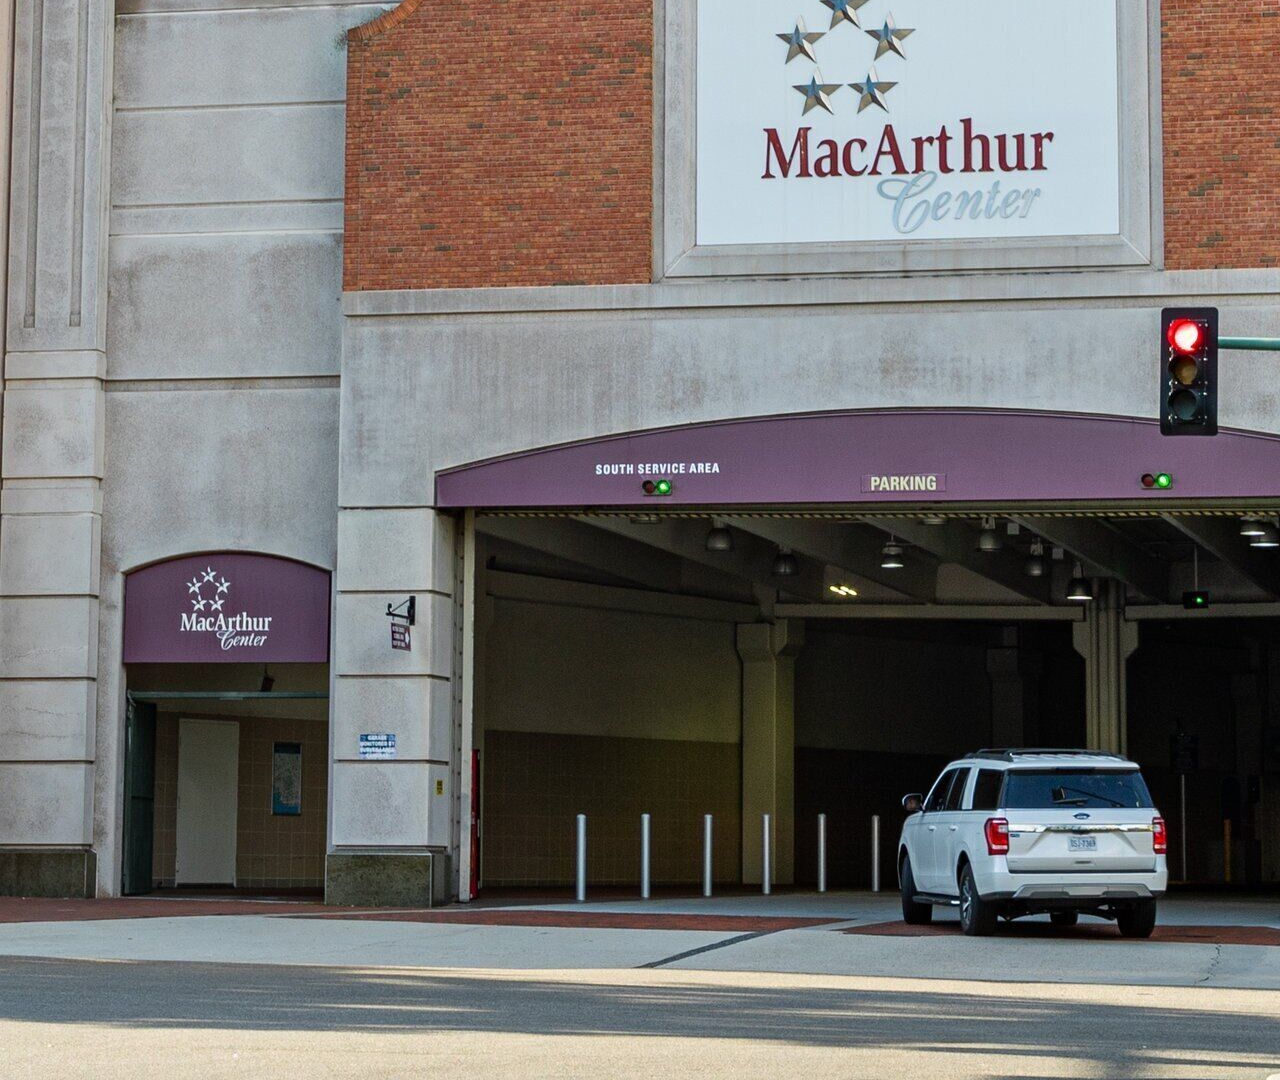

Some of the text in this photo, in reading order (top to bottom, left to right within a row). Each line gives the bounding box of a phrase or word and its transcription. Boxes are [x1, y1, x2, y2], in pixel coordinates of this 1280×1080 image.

[761, 117, 1055, 179] MacArthur
[877, 170, 1042, 234] Center
[595, 462, 720, 475] SOUTH SERVICE AREA
[870, 475, 937, 491] PARKING
[180, 611, 272, 632] MacArthur
[216, 629, 268, 651] Center
